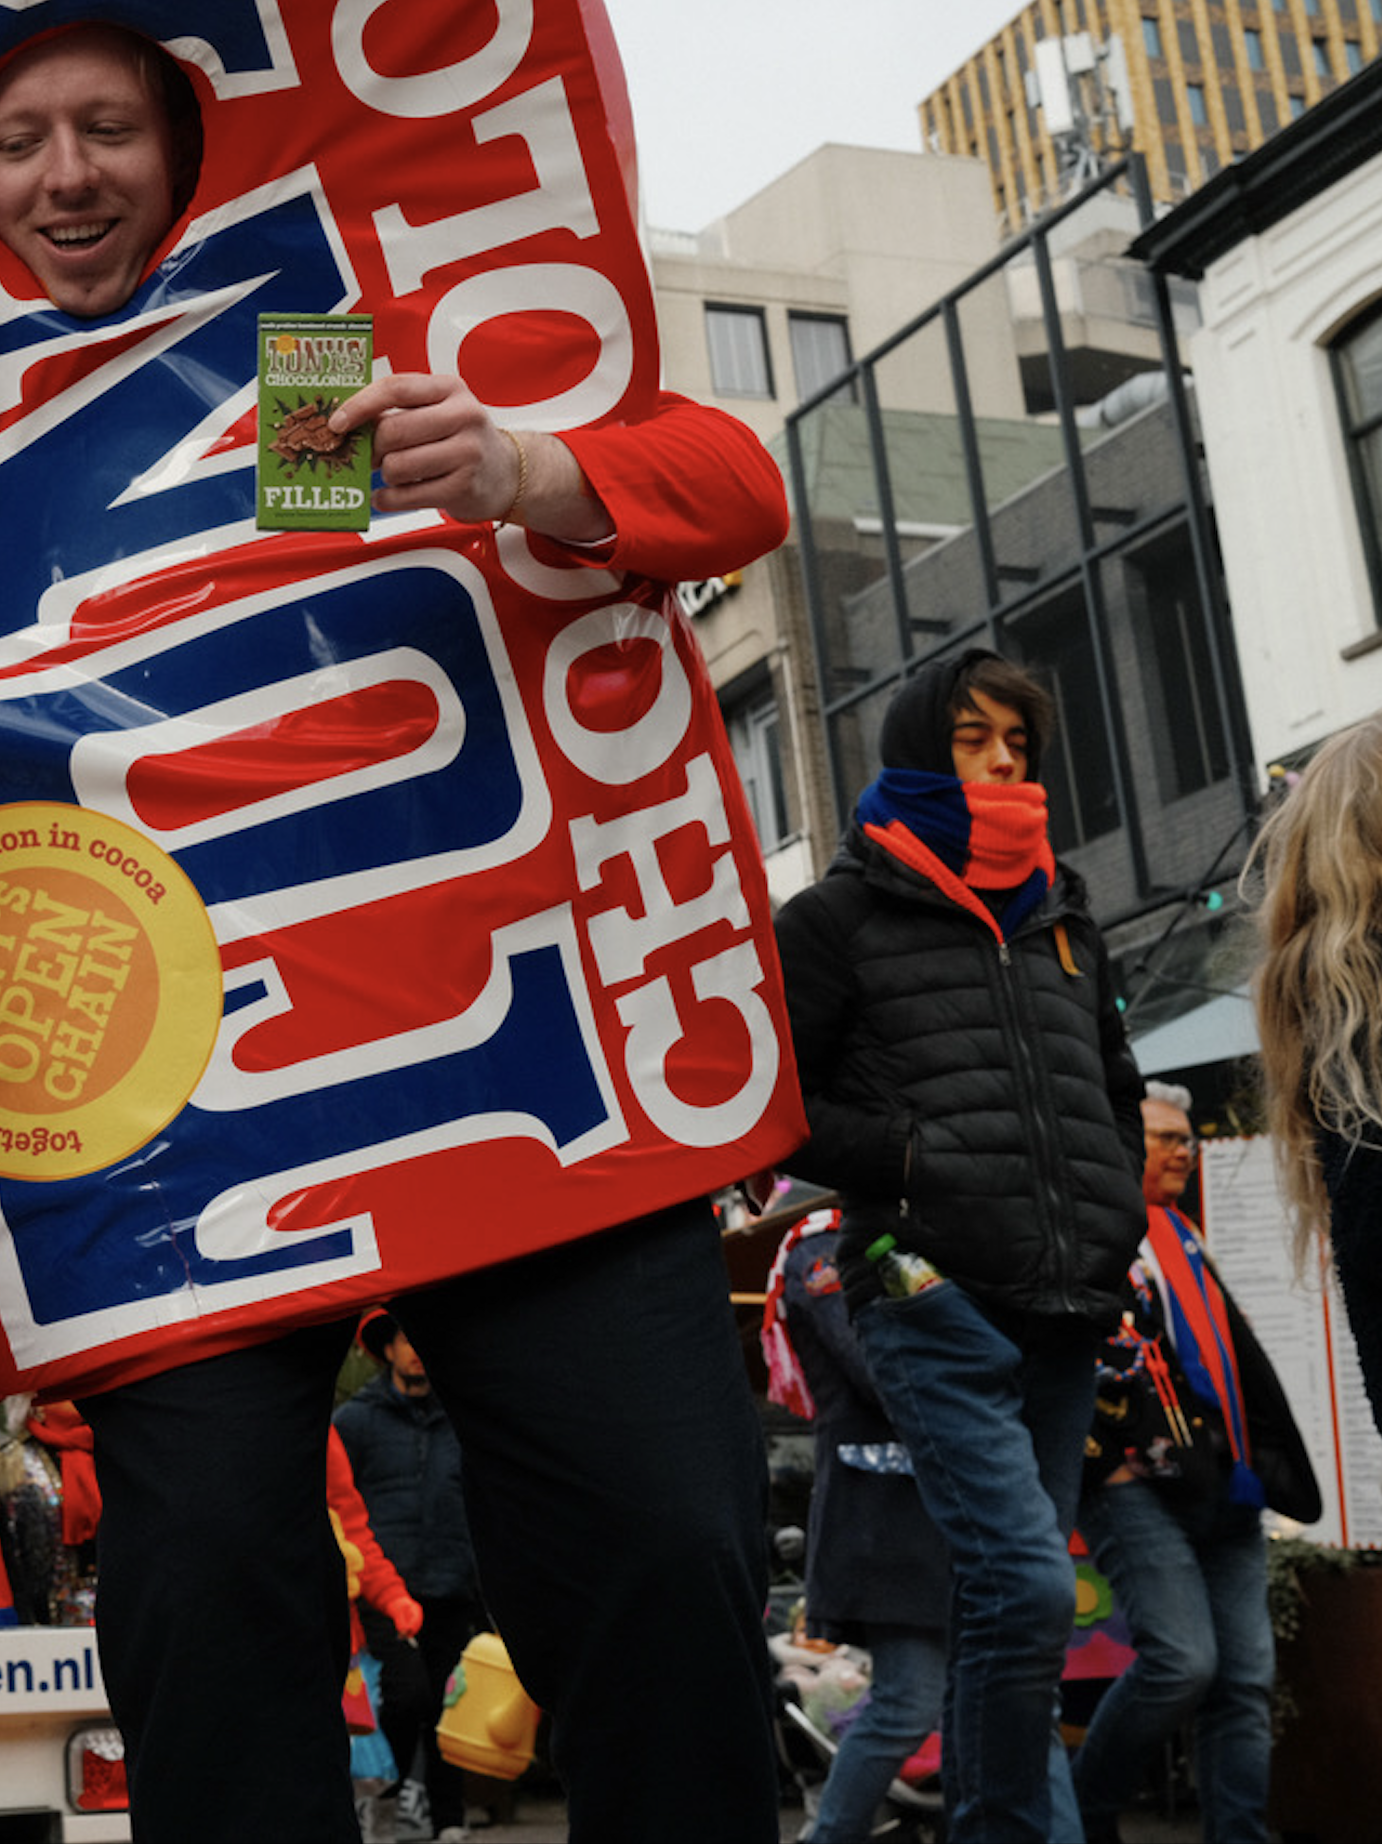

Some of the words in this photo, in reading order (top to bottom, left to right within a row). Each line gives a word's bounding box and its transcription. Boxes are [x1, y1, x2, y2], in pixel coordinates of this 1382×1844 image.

[263, 485, 365, 510] FILLED
[48, 822, 81, 852] in
[88, 839, 167, 906] cocoa
[44, 909, 140, 1101] CHAIN
